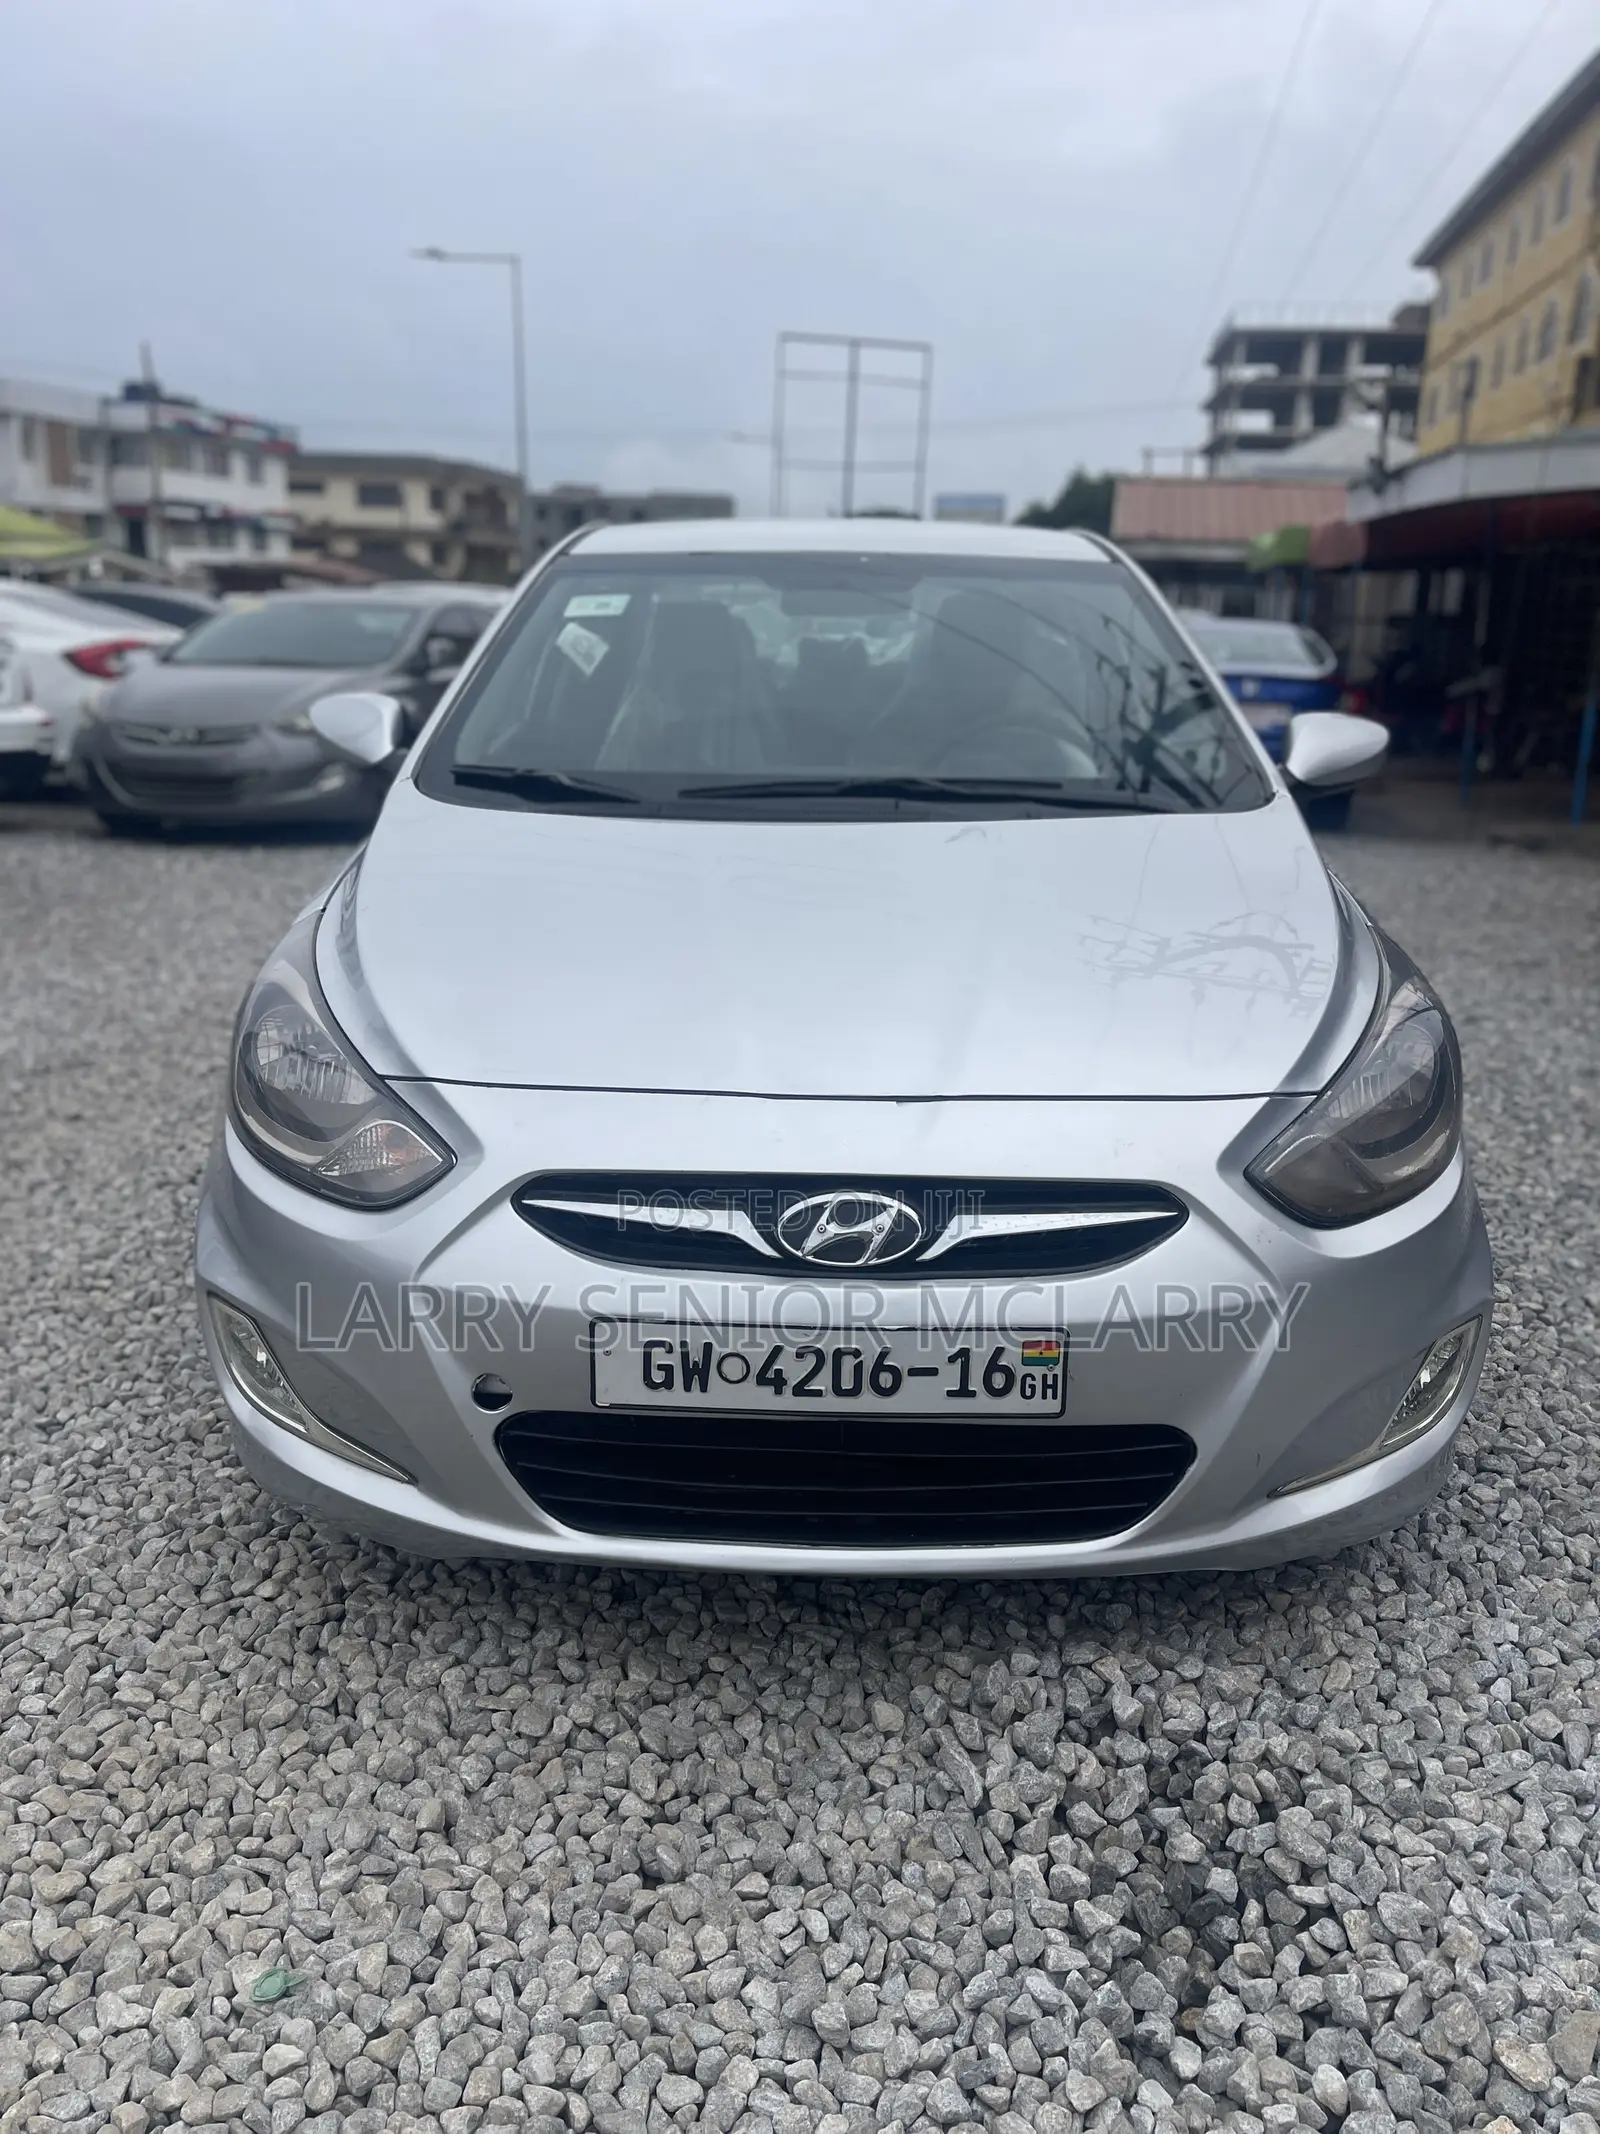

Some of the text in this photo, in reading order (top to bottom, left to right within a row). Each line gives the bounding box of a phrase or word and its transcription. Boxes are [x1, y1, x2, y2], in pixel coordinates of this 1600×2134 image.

[642, 1339, 1016, 1398] GW 4206-16
[1019, 1372, 1059, 1401] GH
